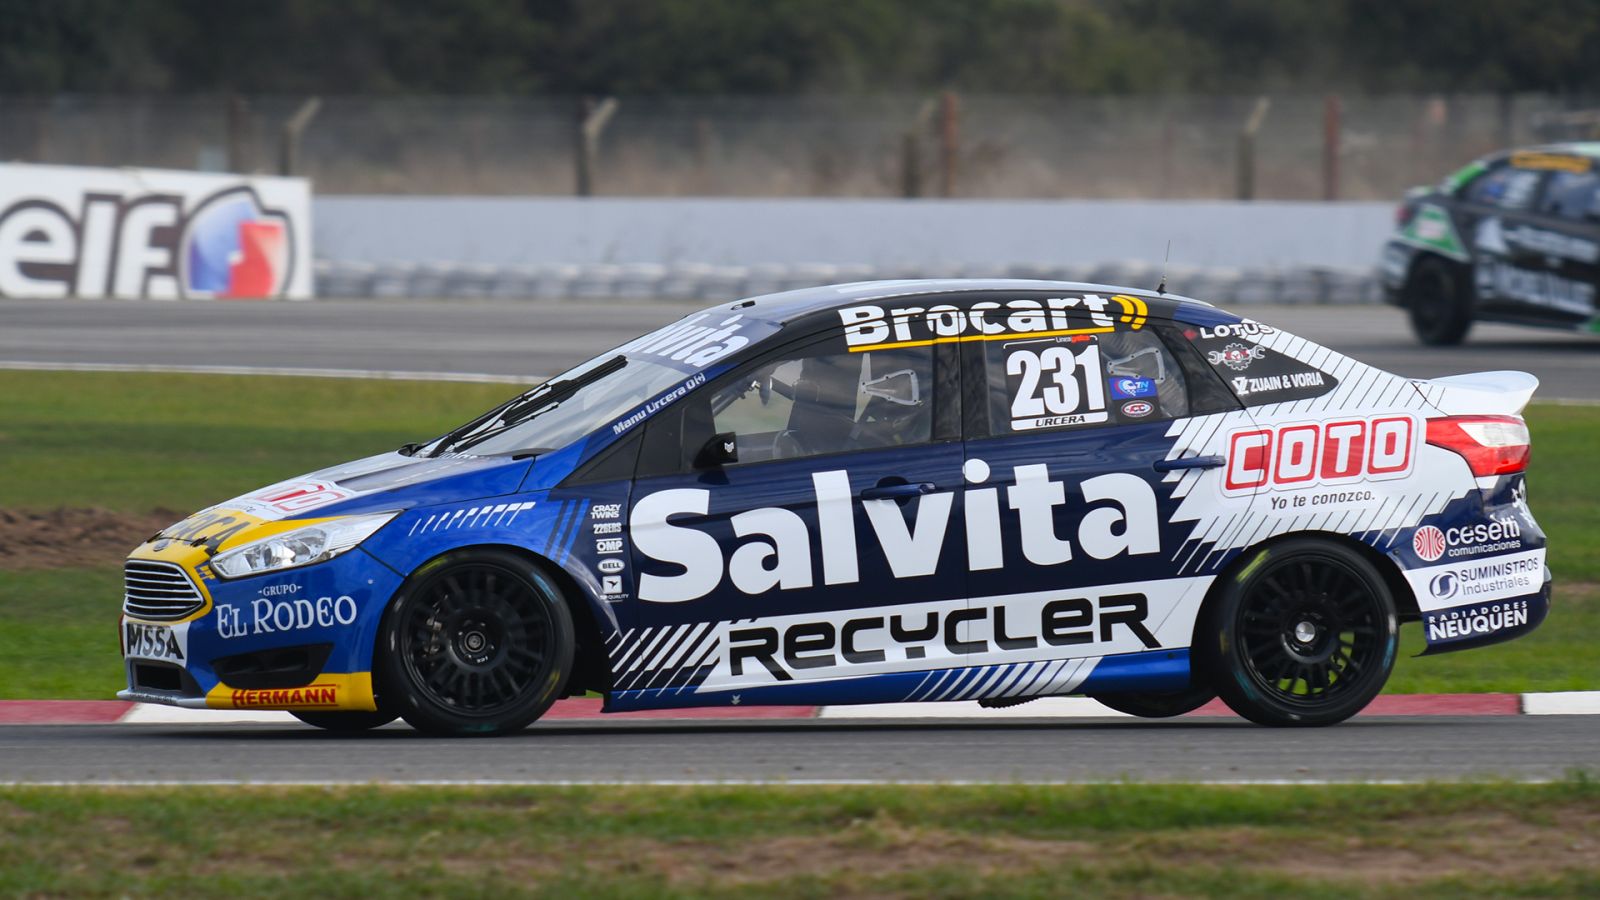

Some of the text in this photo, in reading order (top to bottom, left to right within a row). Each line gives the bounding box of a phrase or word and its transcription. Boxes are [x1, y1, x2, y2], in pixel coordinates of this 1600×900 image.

[837, 293, 1114, 347] Brocart
[1199, 322, 1275, 340] LOTUS
[1006, 344, 1105, 419] 231
[1250, 376, 1282, 393] ZUAIN
[1282, 374, 1291, 389] &
[1290, 371, 1325, 388] VORIA
[612, 410, 647, 436] Manu
[646, 385, 686, 414] Urcera
[1035, 414, 1086, 428] URCERA
[1225, 416, 1413, 491] COTO
[592, 504, 622, 512] CRAZY
[1270, 496, 1287, 510] Yo
[1293, 495, 1306, 508] te
[590, 510, 620, 519] TWINS
[629, 458, 1161, 603] Salvita
[1446, 515, 1521, 546] cesetti
[596, 540, 623, 551] OMP
[1448, 539, 1521, 558] comunicaciones
[602, 561, 621, 569] BELL
[1460, 557, 1539, 582] SUMINISTROS
[1462, 575, 1530, 596] Industriales
[216, 595, 357, 639] EL RODEO
[1428, 601, 1528, 623] RADIADORES
[1428, 608, 1528, 641] NEUQUEN
[126, 622, 185, 660] MSSA
[231, 686, 337, 706] HERMANN
